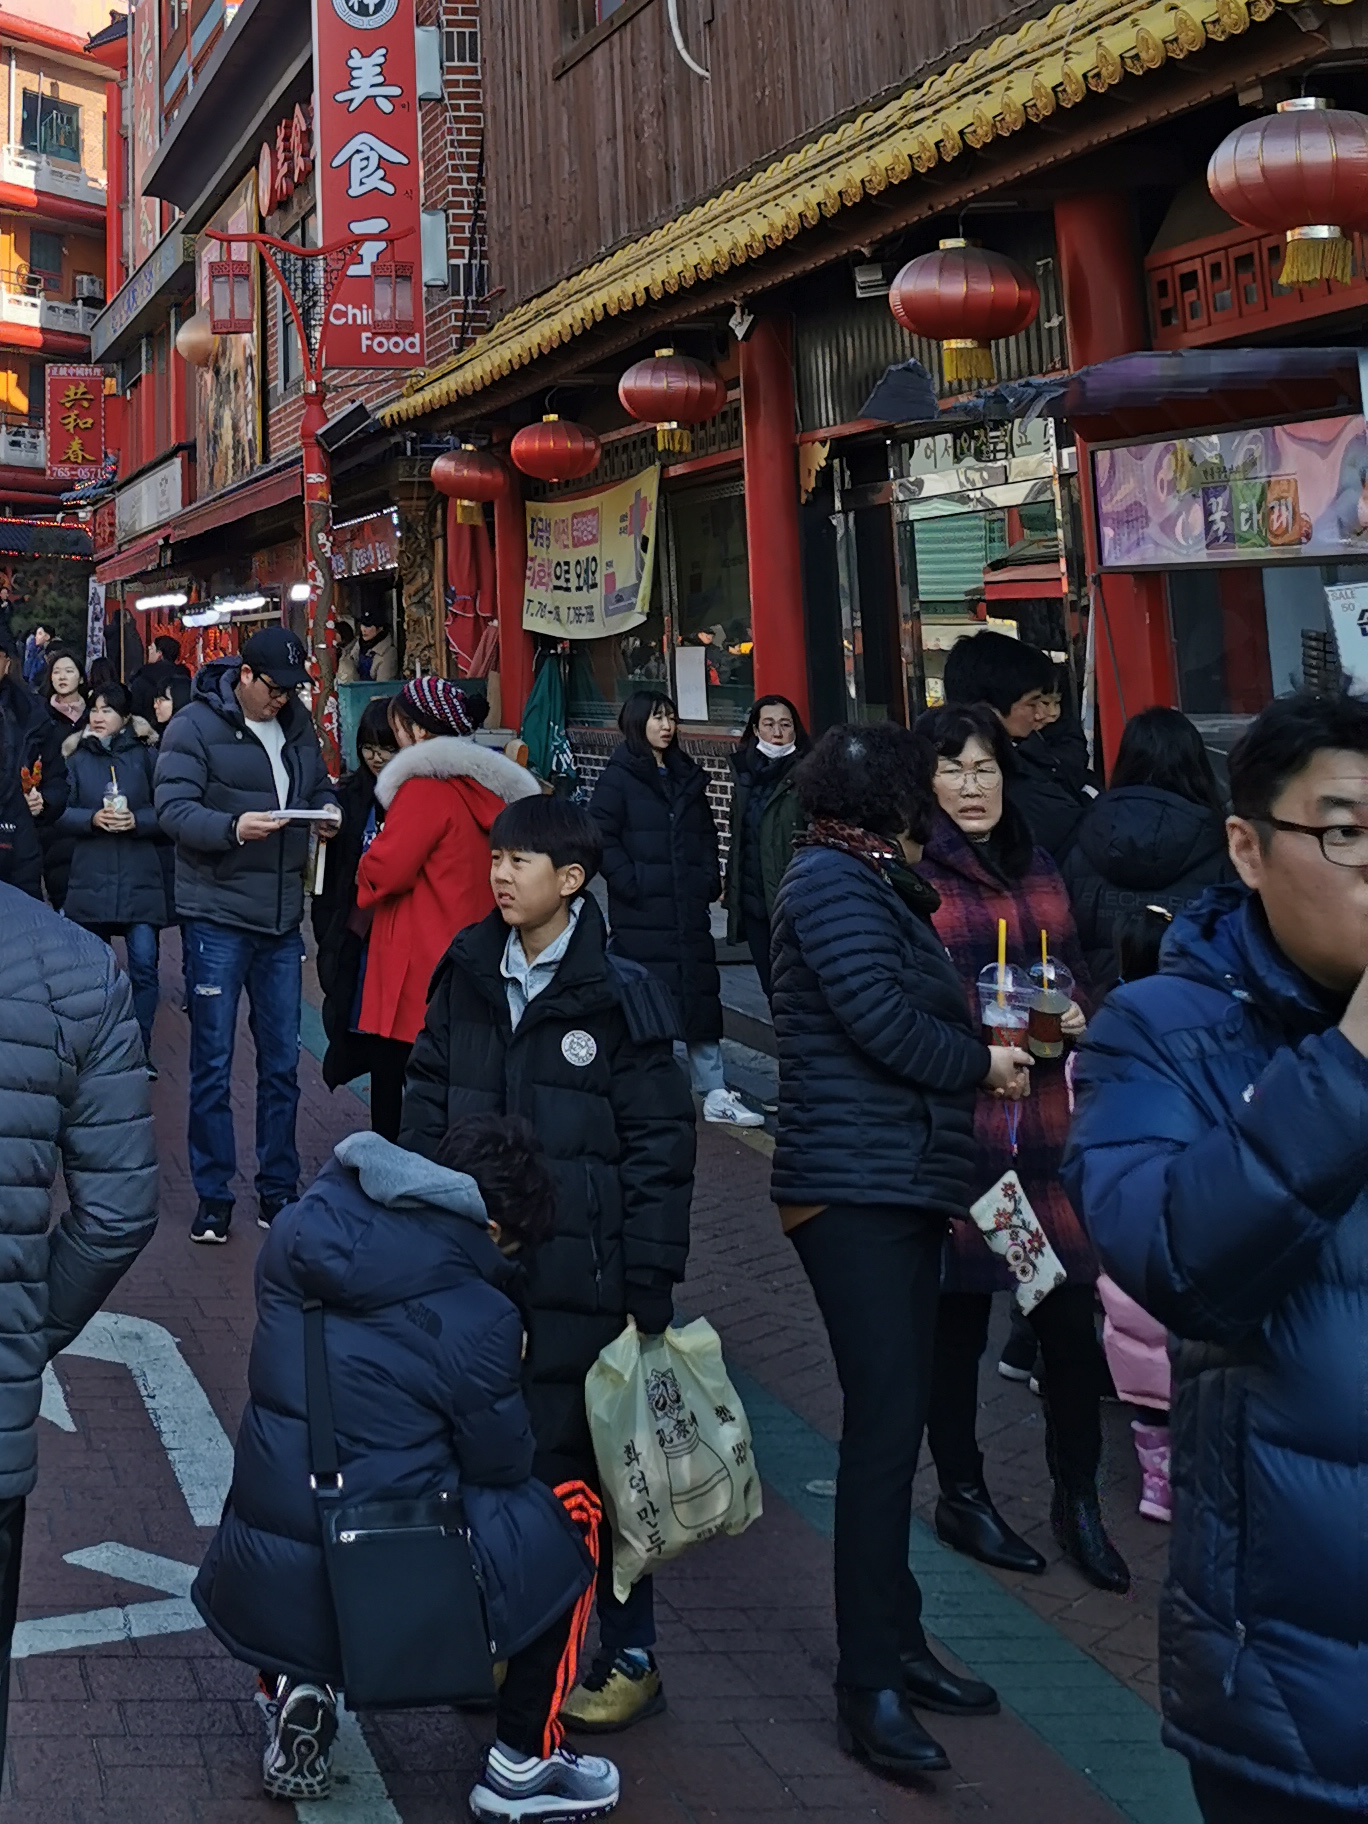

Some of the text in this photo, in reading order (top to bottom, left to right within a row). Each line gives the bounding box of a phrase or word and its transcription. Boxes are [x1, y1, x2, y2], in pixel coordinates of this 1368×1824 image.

[361, 332, 420, 354] Food
[58, 381, 97, 463] 共和春
[52, 467, 101, 479] 765-0571
